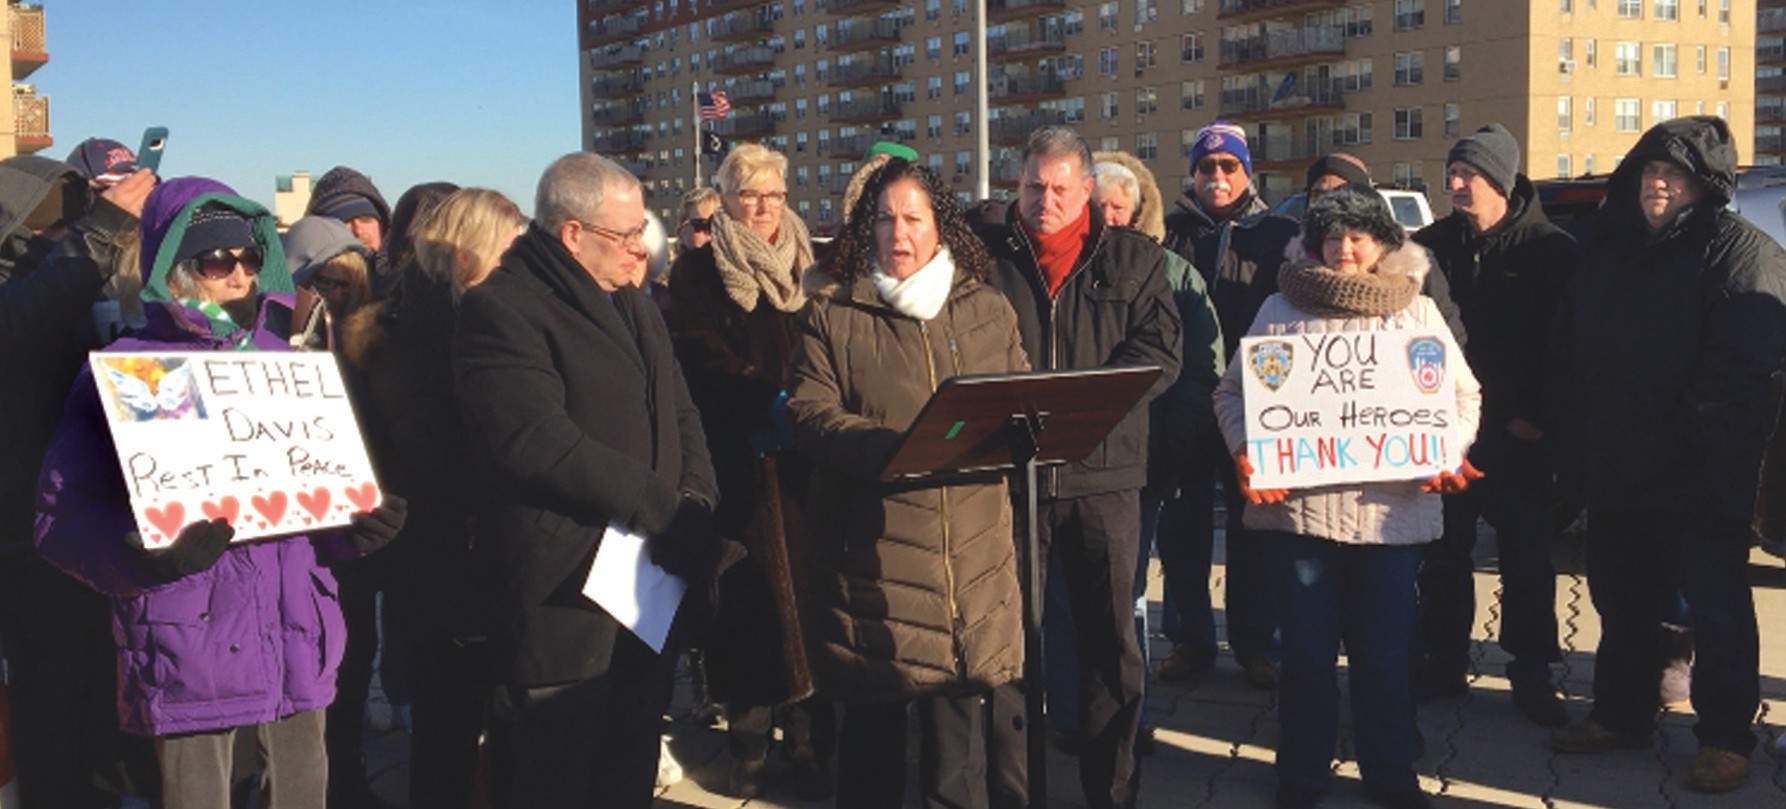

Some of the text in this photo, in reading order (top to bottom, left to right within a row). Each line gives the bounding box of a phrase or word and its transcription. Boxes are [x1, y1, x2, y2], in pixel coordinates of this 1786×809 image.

[1302, 334, 1378, 371] YOU
[204, 360, 344, 399] ETHEL
[1310, 369, 1375, 395] ARE
[222, 408, 334, 442] DAVIS
[1250, 433, 1447, 475] THANK YOU!!
